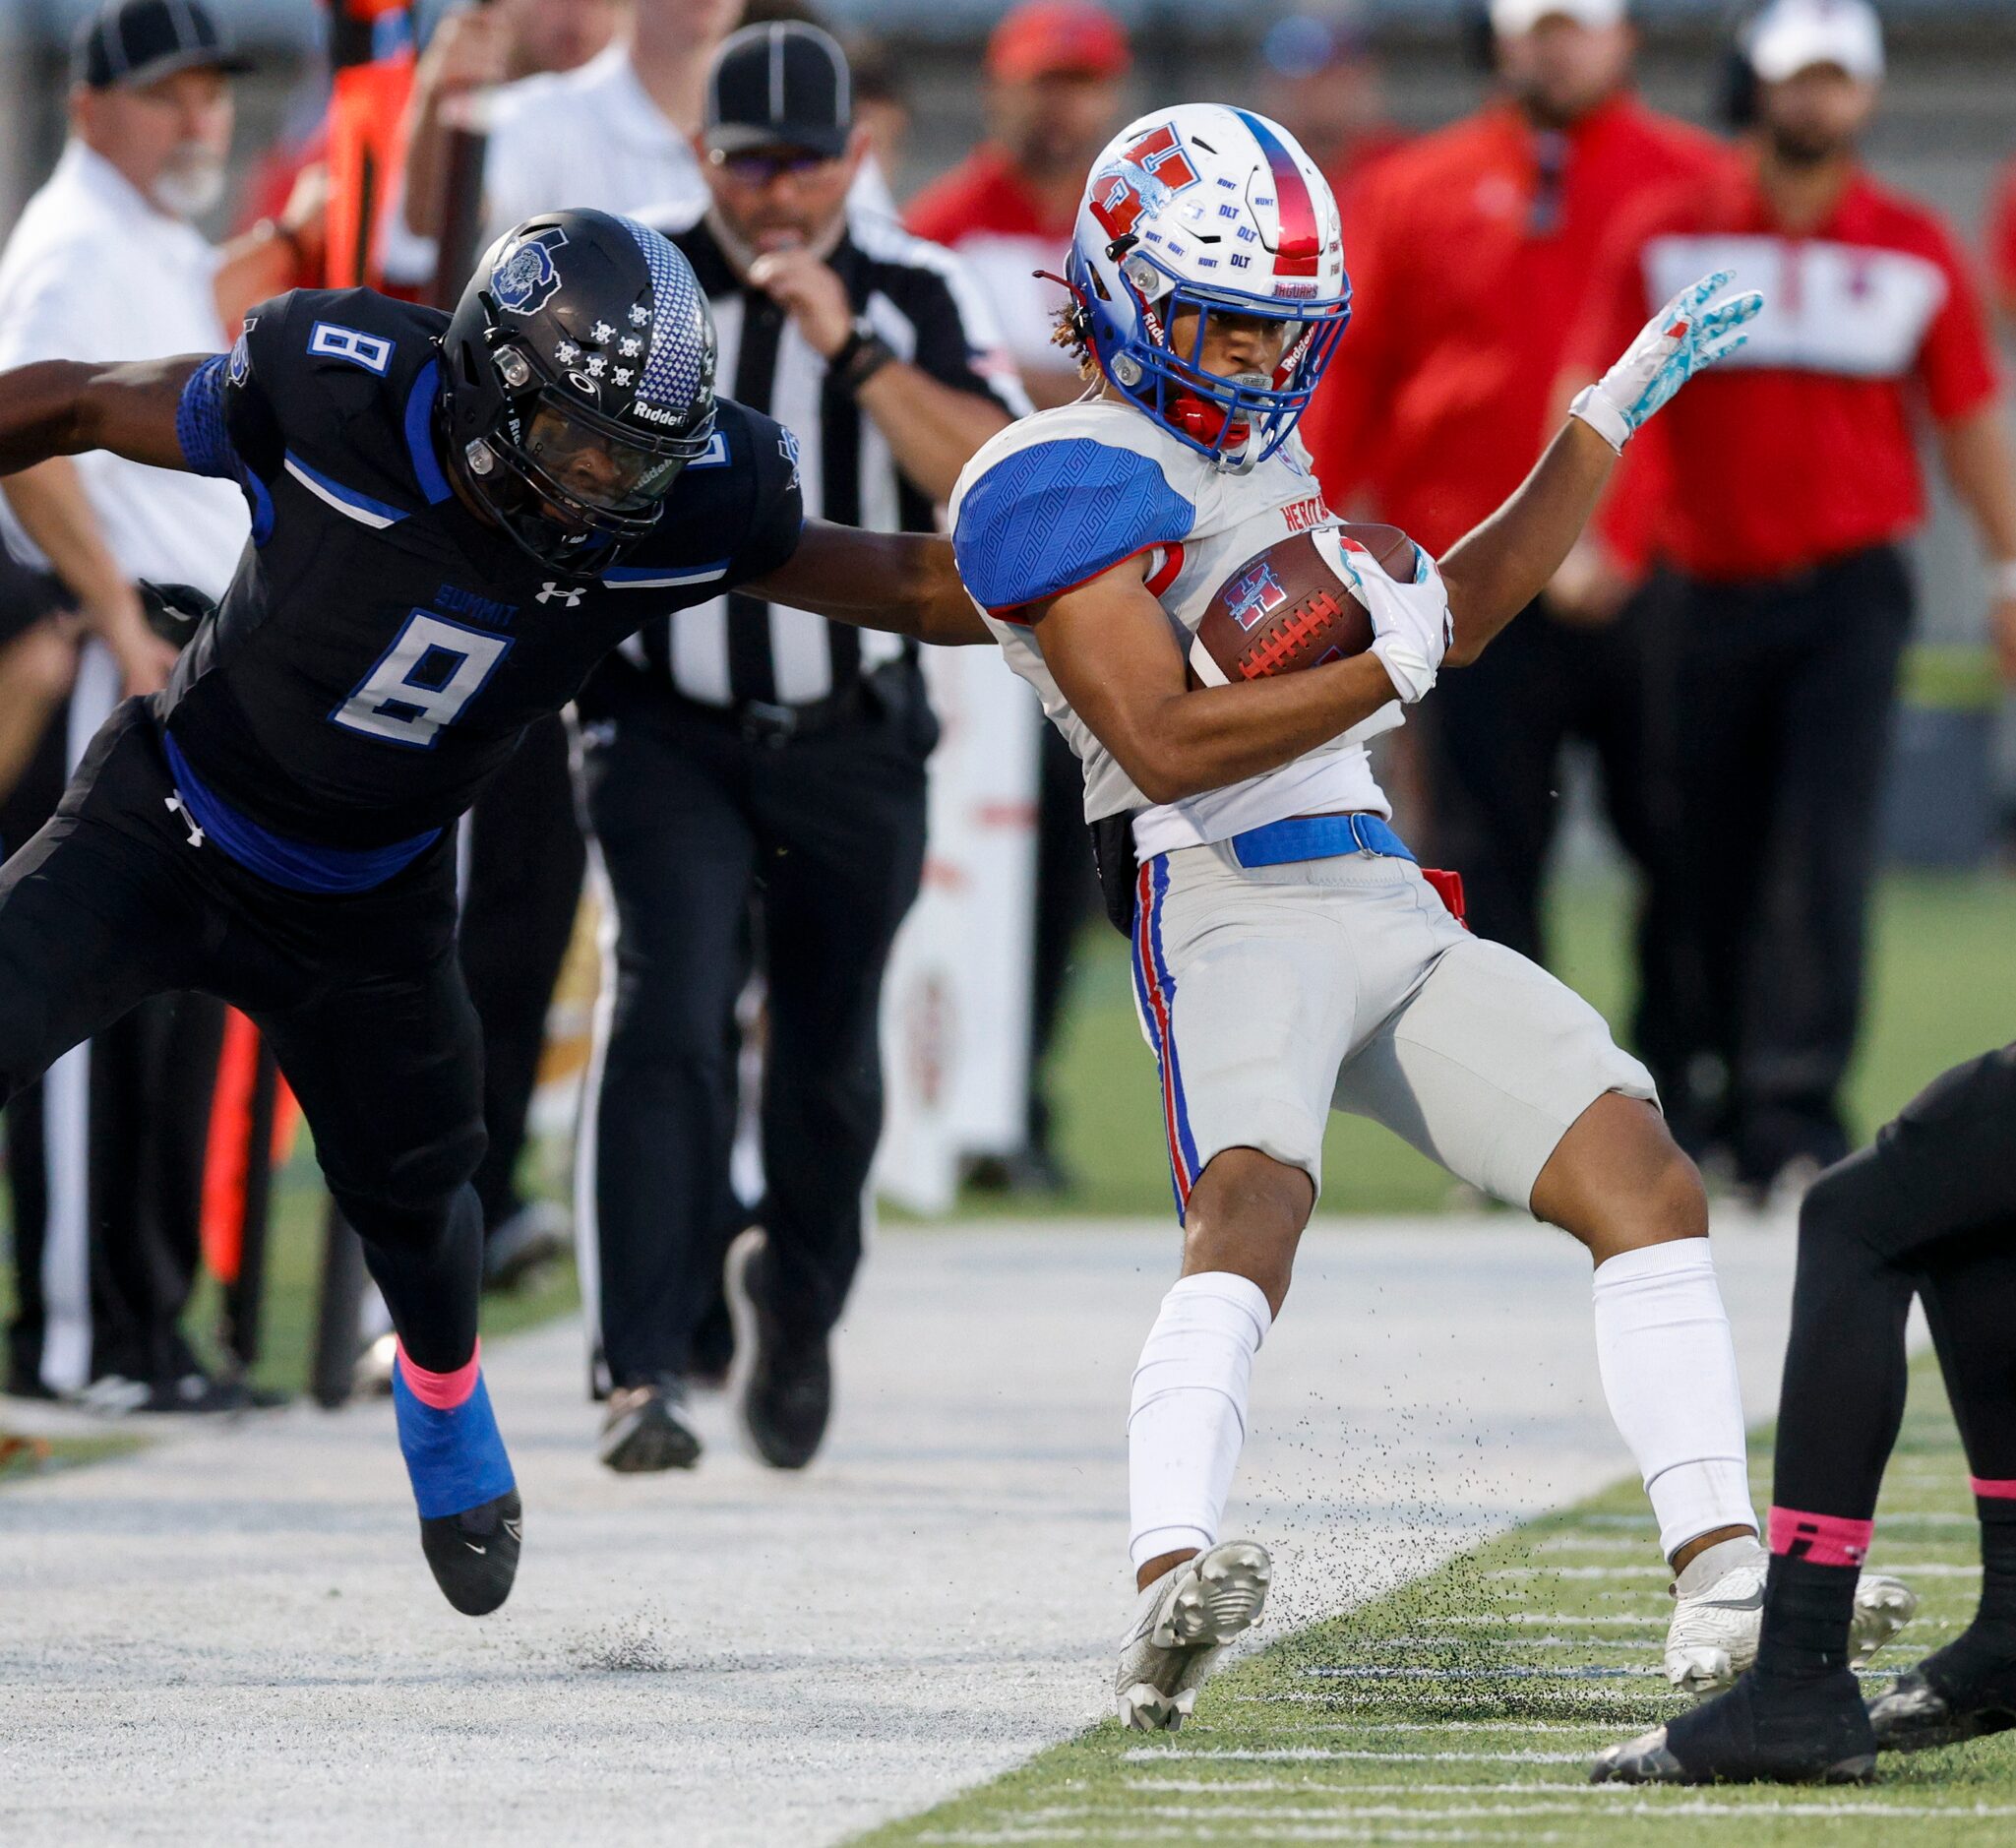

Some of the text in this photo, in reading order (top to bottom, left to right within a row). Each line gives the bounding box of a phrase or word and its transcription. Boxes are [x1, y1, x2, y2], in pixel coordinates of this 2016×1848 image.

[1218, 204, 1240, 220] DLT
[1236, 225, 1257, 243] DLT
[1197, 257, 1218, 269] HUNT
[1230, 253, 1252, 269] DLT
[306, 320, 397, 378] 8
[433, 582, 520, 628] SUMMIT
[327, 607, 516, 750] 8
